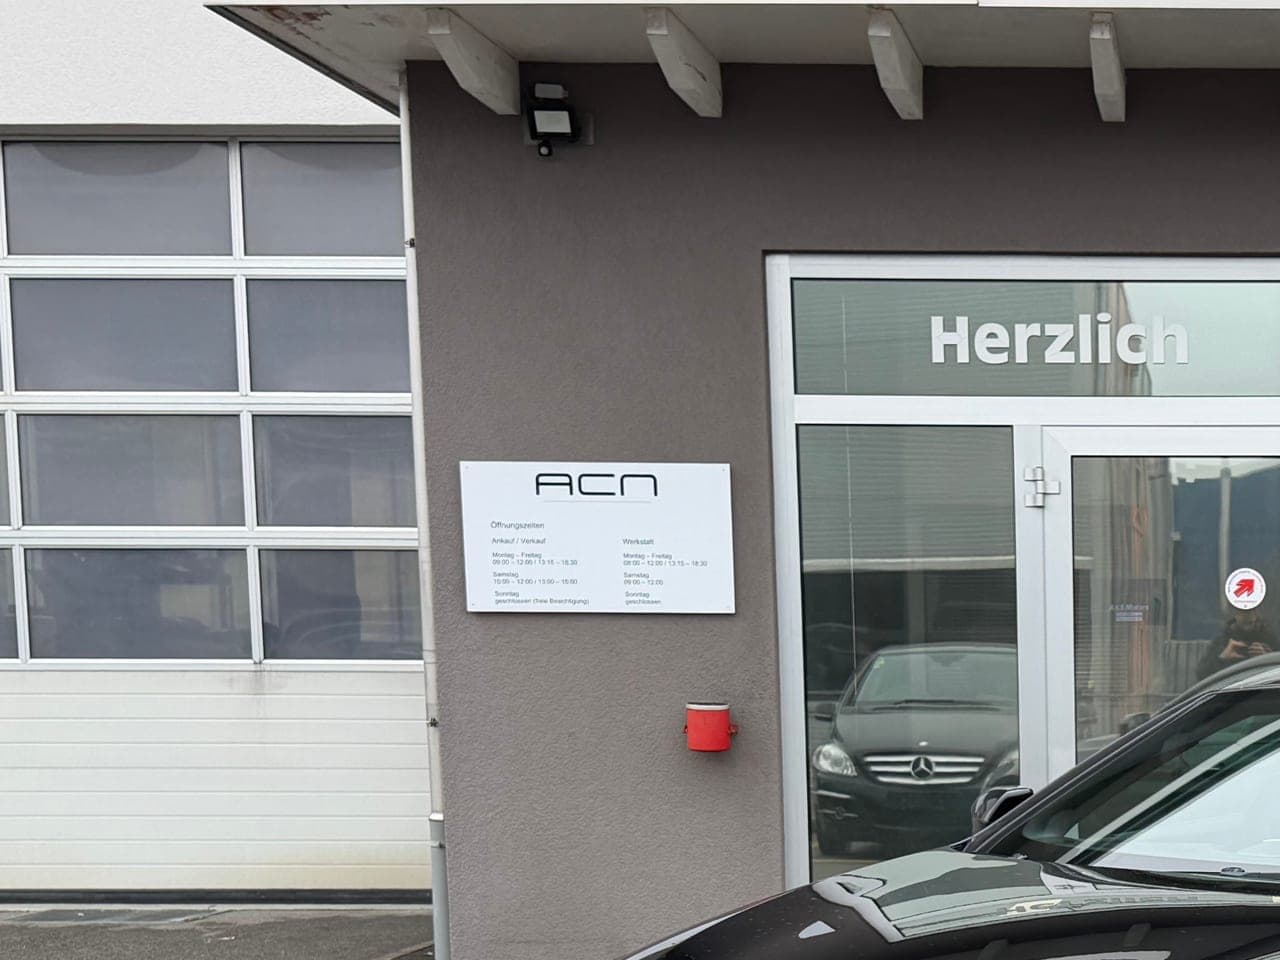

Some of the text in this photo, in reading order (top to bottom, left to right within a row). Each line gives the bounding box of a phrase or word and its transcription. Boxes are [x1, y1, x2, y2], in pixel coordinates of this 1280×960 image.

[930, 312, 1189, 365] Herzlich
[535, 473, 658, 496] ACN
[490, 520, 545, 530] Öffnungszeiten
